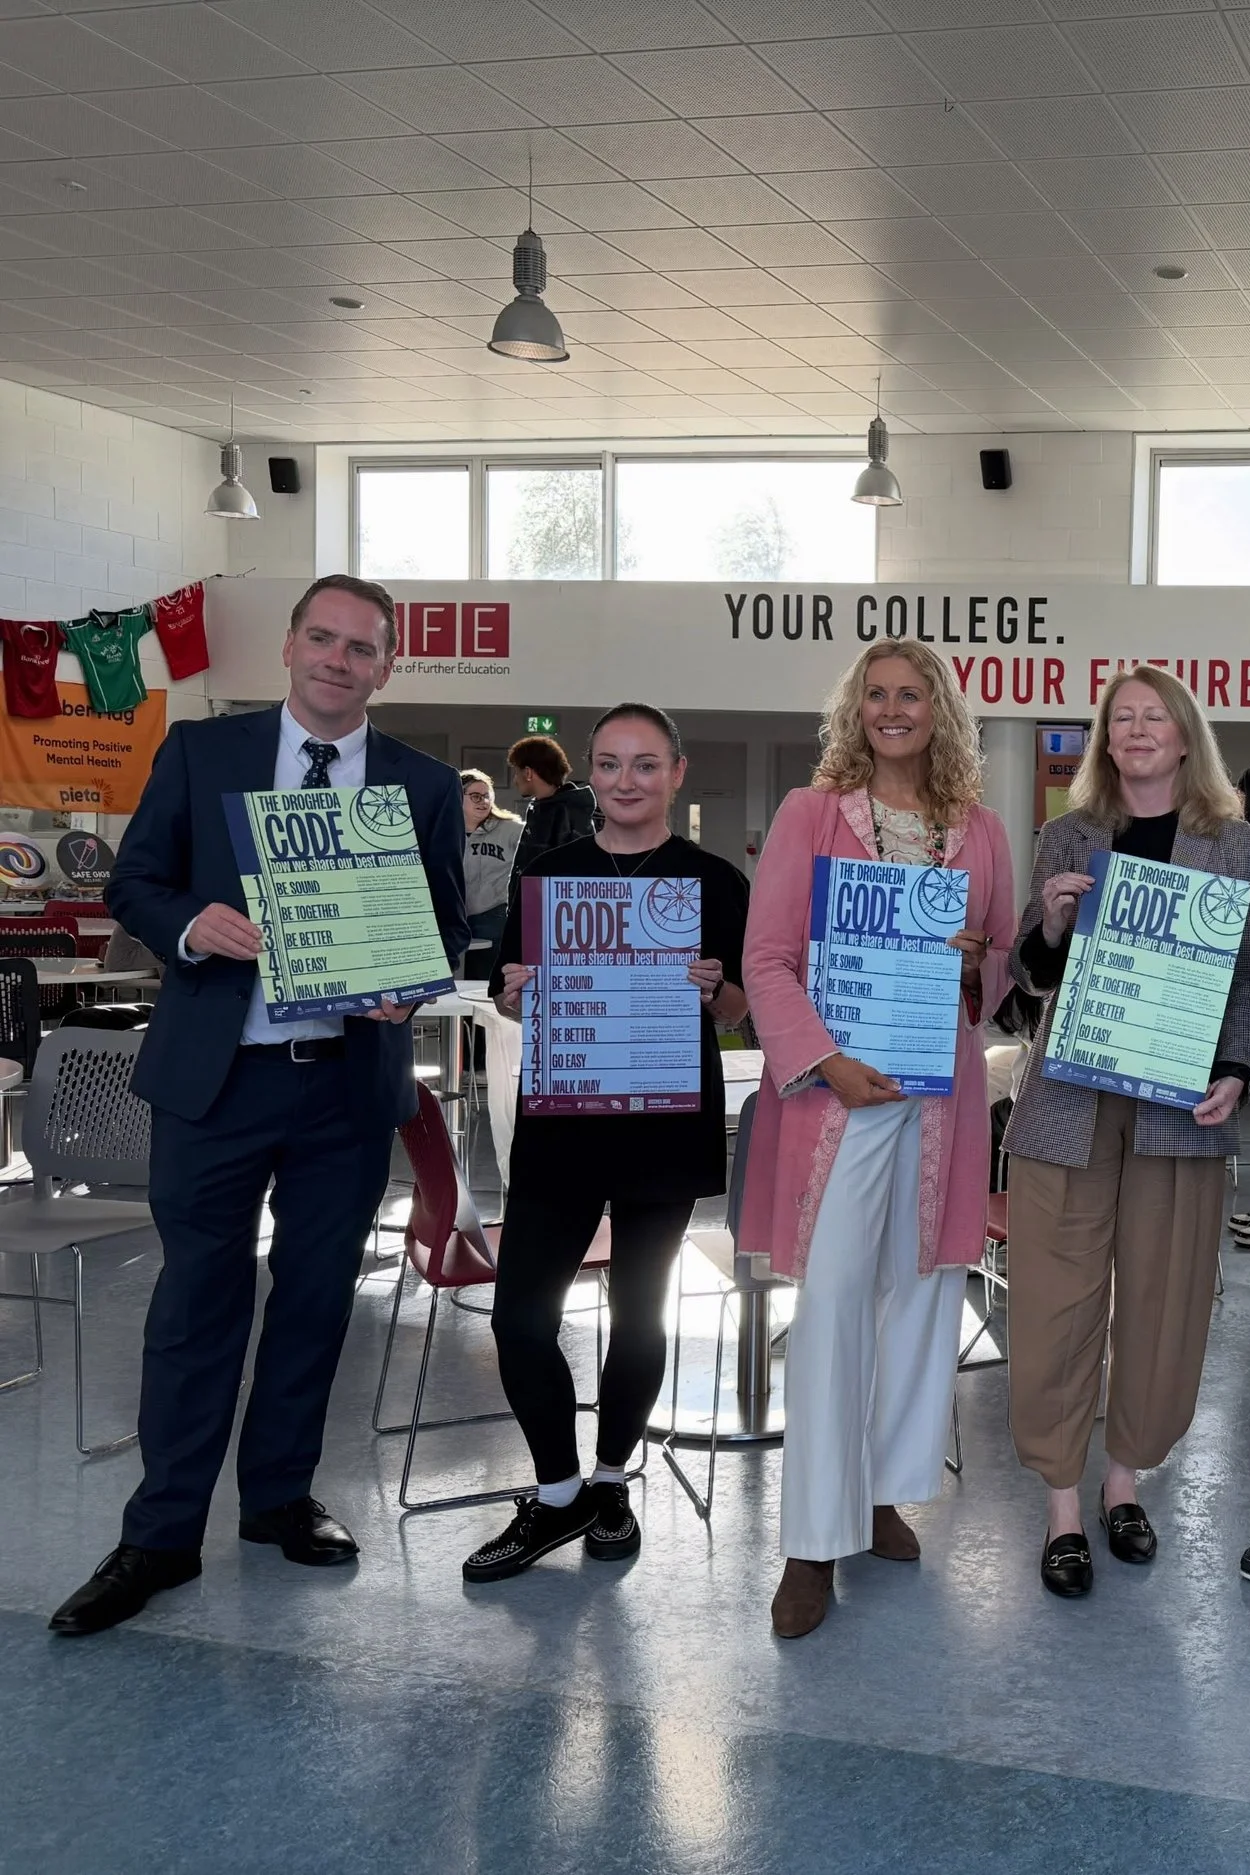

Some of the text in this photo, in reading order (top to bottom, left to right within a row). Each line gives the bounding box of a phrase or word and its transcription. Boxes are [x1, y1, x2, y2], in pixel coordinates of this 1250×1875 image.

[724, 593, 1066, 645] YOUR COLLEGE.
[405, 661, 417, 674] of
[418, 662, 456, 674] Further
[458, 662, 511, 675] Education
[952, 656, 1065, 705] YOUR
[62, 699, 93, 717] ber
[33, 735, 133, 753] Promoting Positive
[46, 753, 122, 768] Mental Health
[60, 787, 101, 804] pieta
[258, 793, 341, 812] THE DROGHEDA
[265, 811, 351, 858] CODE
[471, 842, 506, 861] YORK
[269, 852, 422, 873] how we share our best moments
[840, 862, 905, 885] THE DROGHEDA
[1118, 860, 1191, 892] THE DROGHEDA
[275, 881, 320, 896] BE SOUND
[555, 882, 632, 899] THE DROGHEDA
[280, 905, 339, 922] BE TOGETHER
[837, 883, 904, 935] CODE
[1108, 879, 1186, 940] CODE
[555, 902, 632, 949] CODE
[285, 931, 333, 947] BE BETTER
[832, 928, 848, 944] how
[847, 933, 859, 946] we
[860, 933, 885, 948] share
[885, 937, 899, 950] our
[902, 937, 920, 952] best
[1101, 925, 1237, 970] how we share our best moments
[291, 957, 329, 973] GO EASY
[552, 951, 700, 965] how we share our best moments
[1096, 949, 1135, 970] BE SOUND
[296, 981, 349, 999] WALK AWAY
[552, 976, 593, 989] BE SOUND
[1090, 974, 1141, 998] BE TOGETHER
[552, 1002, 606, 1015] BE TOGETHER
[1084, 999, 1125, 1021] BE BETTER
[552, 1028, 595, 1041] BE BETTER
[1079, 1024, 1111, 1044] GO EASY
[1072, 1049, 1118, 1072] WALK AWAY
